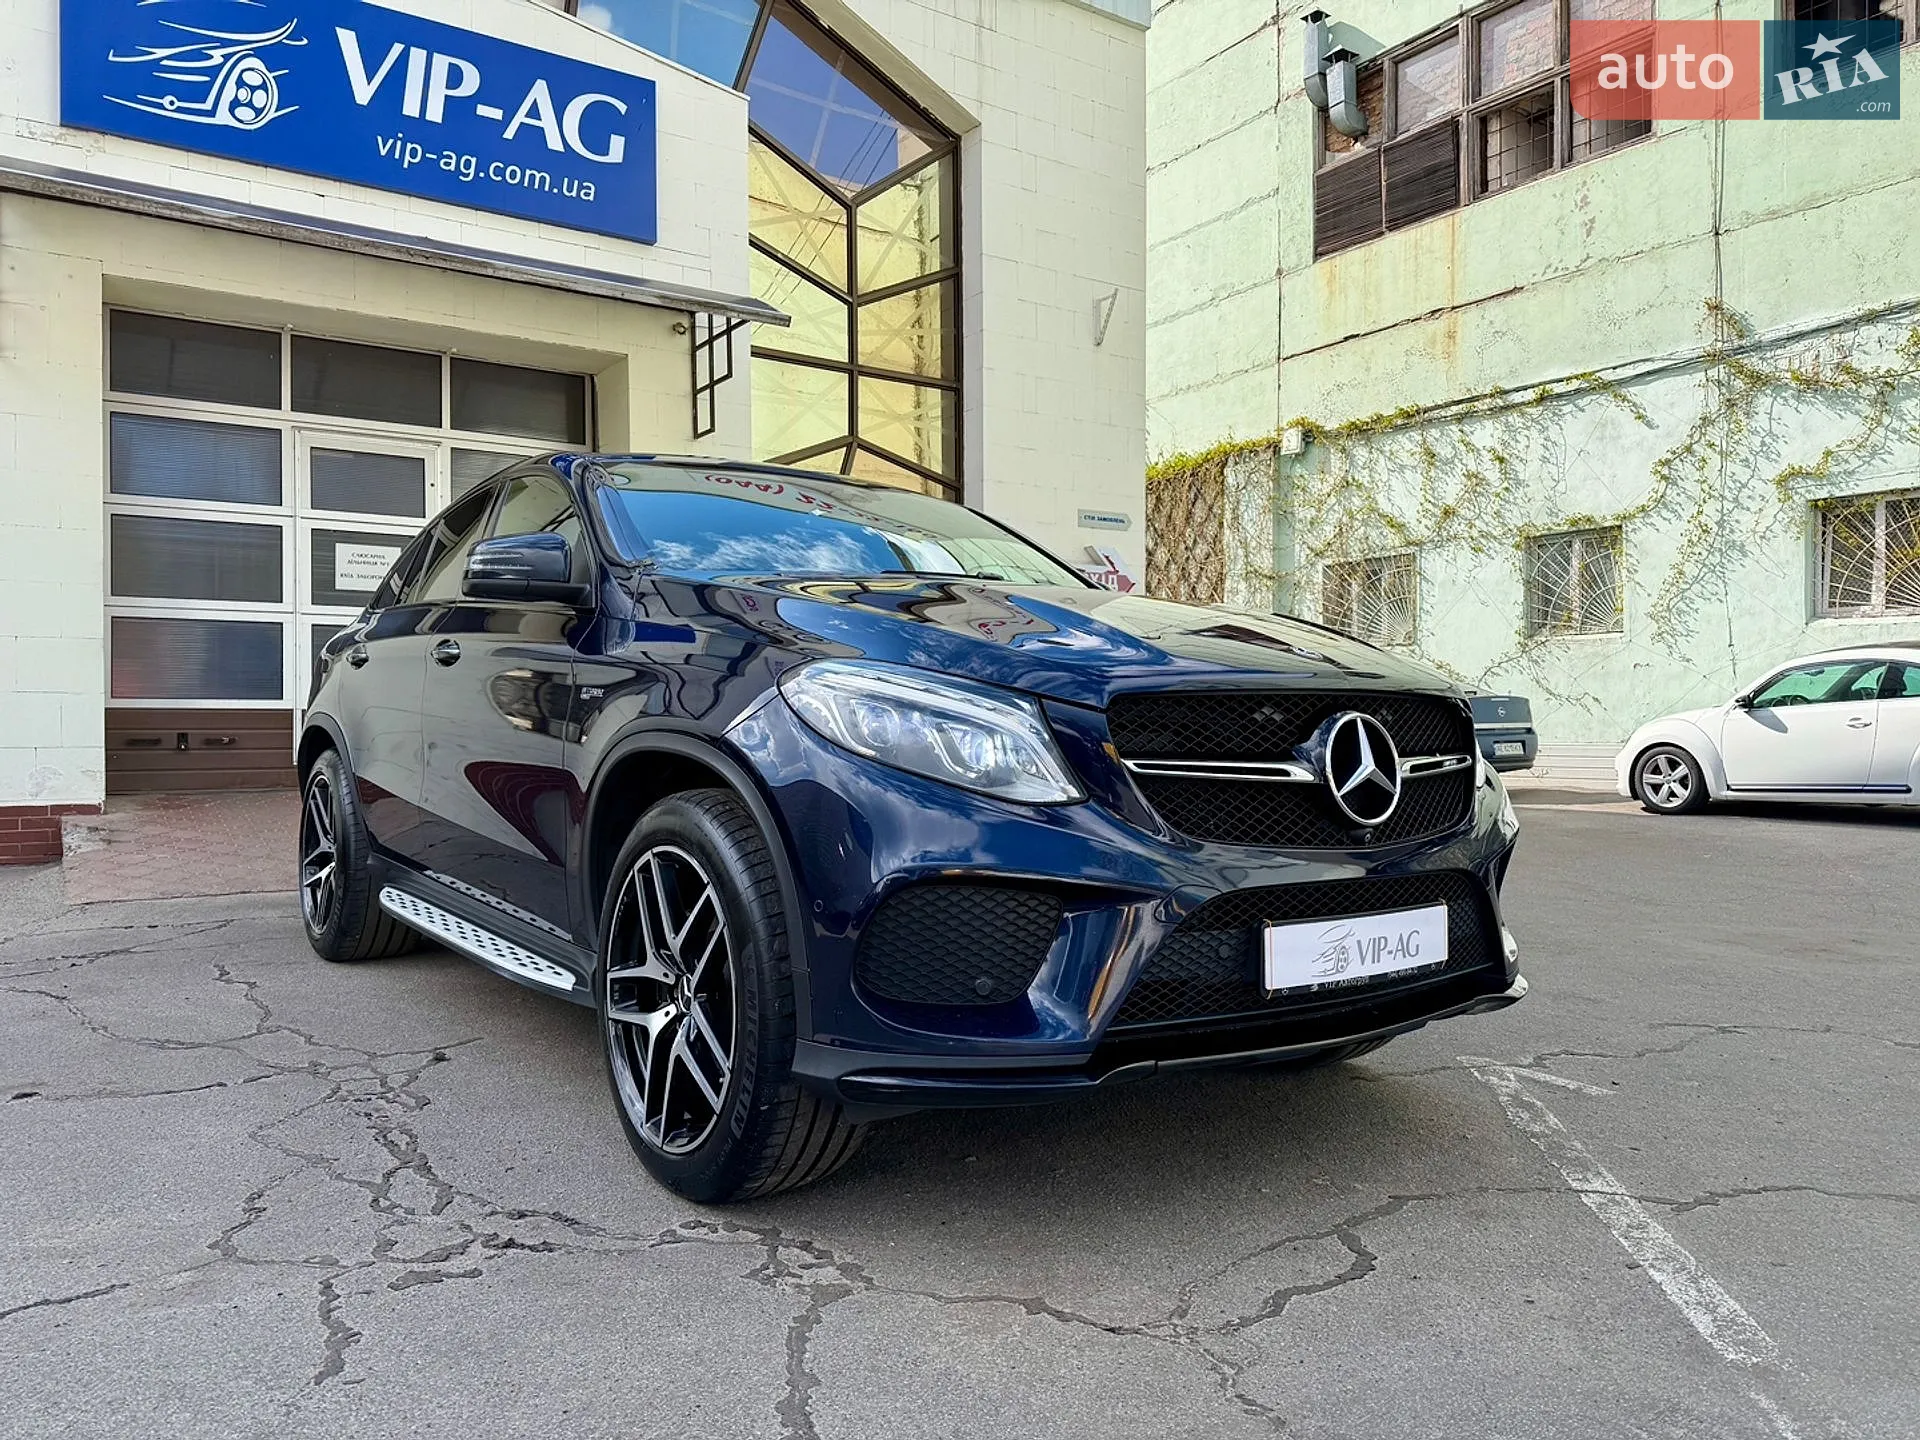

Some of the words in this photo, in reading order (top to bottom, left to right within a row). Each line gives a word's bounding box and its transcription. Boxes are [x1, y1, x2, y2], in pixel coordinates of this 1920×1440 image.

[335, 26, 628, 164] VIP-AG
[376, 132, 596, 201] vip-ag.com.ua
[1356, 929, 1421, 966] VIP-AG
[733, 986, 759, 1132] MICHELIN
